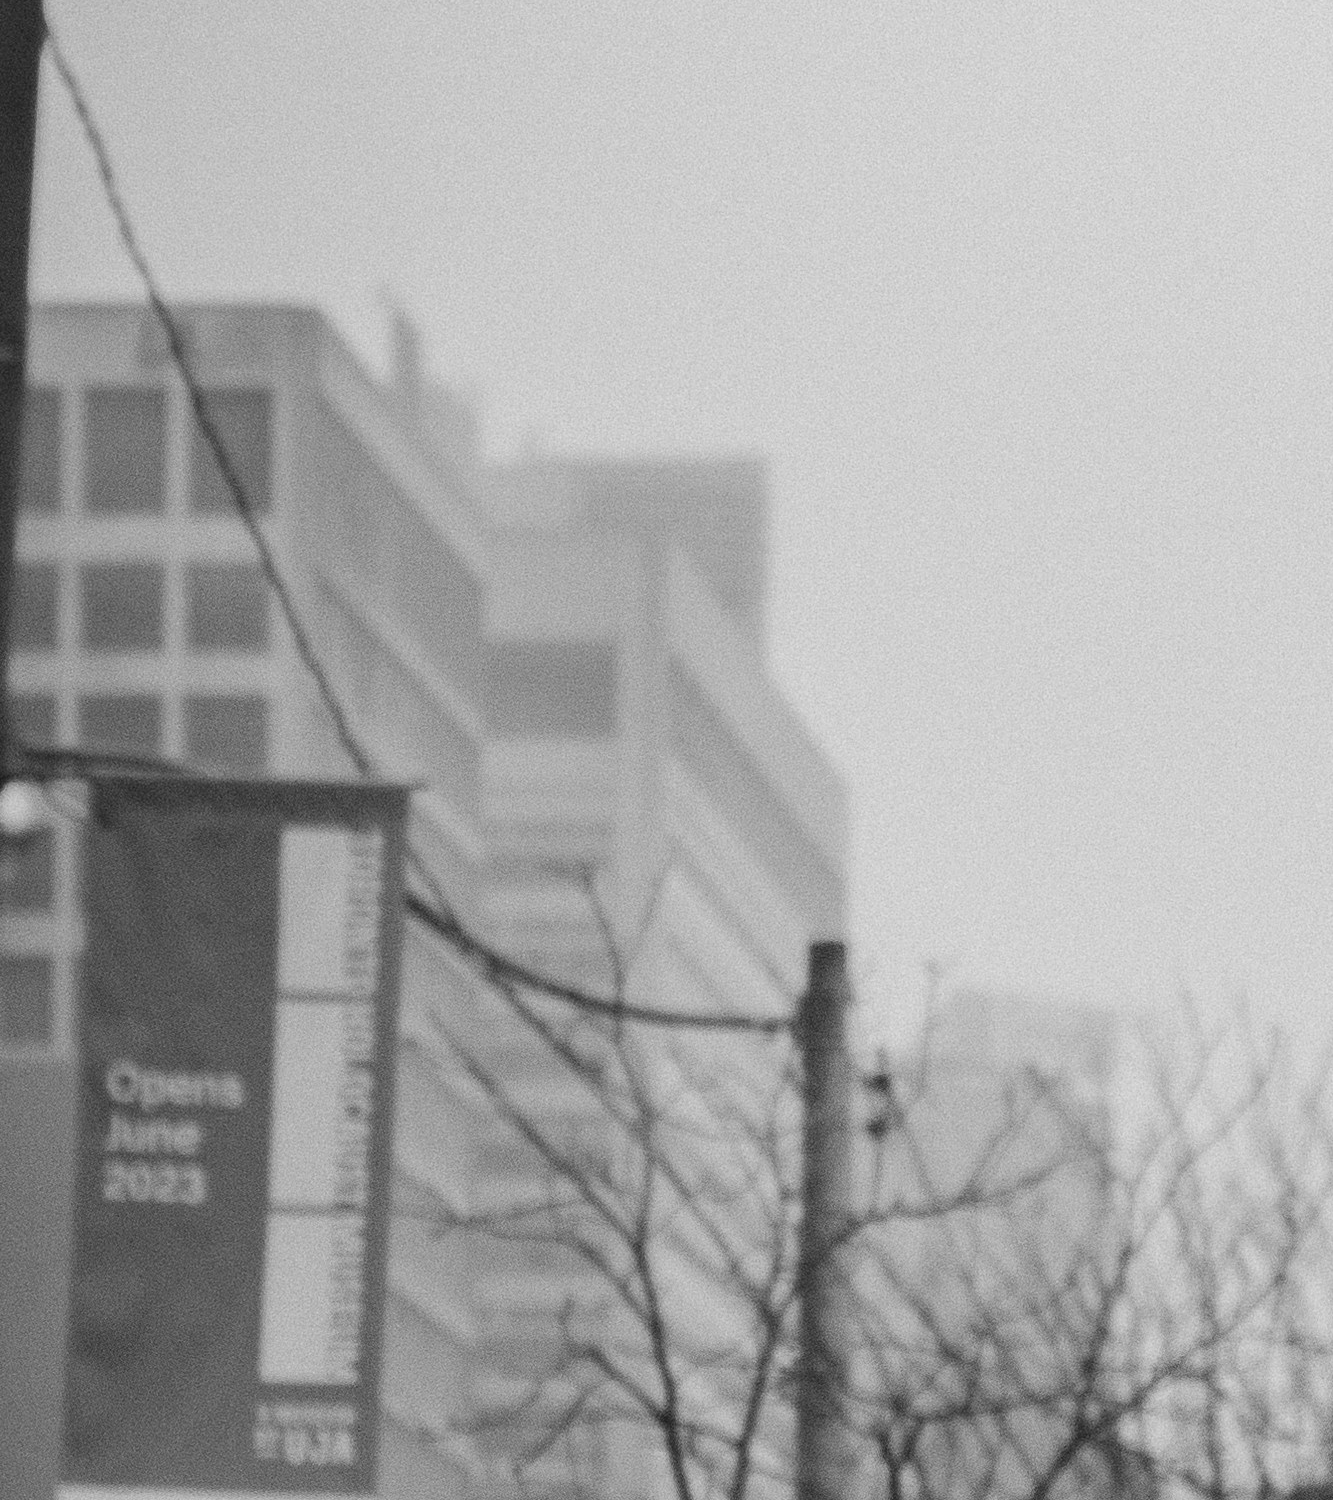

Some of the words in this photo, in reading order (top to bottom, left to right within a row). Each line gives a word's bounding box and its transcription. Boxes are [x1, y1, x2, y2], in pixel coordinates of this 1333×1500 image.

[104, 1058, 246, 1112] Opens
[104, 1111, 204, 1156] June
[102, 1160, 208, 1204] 2023
